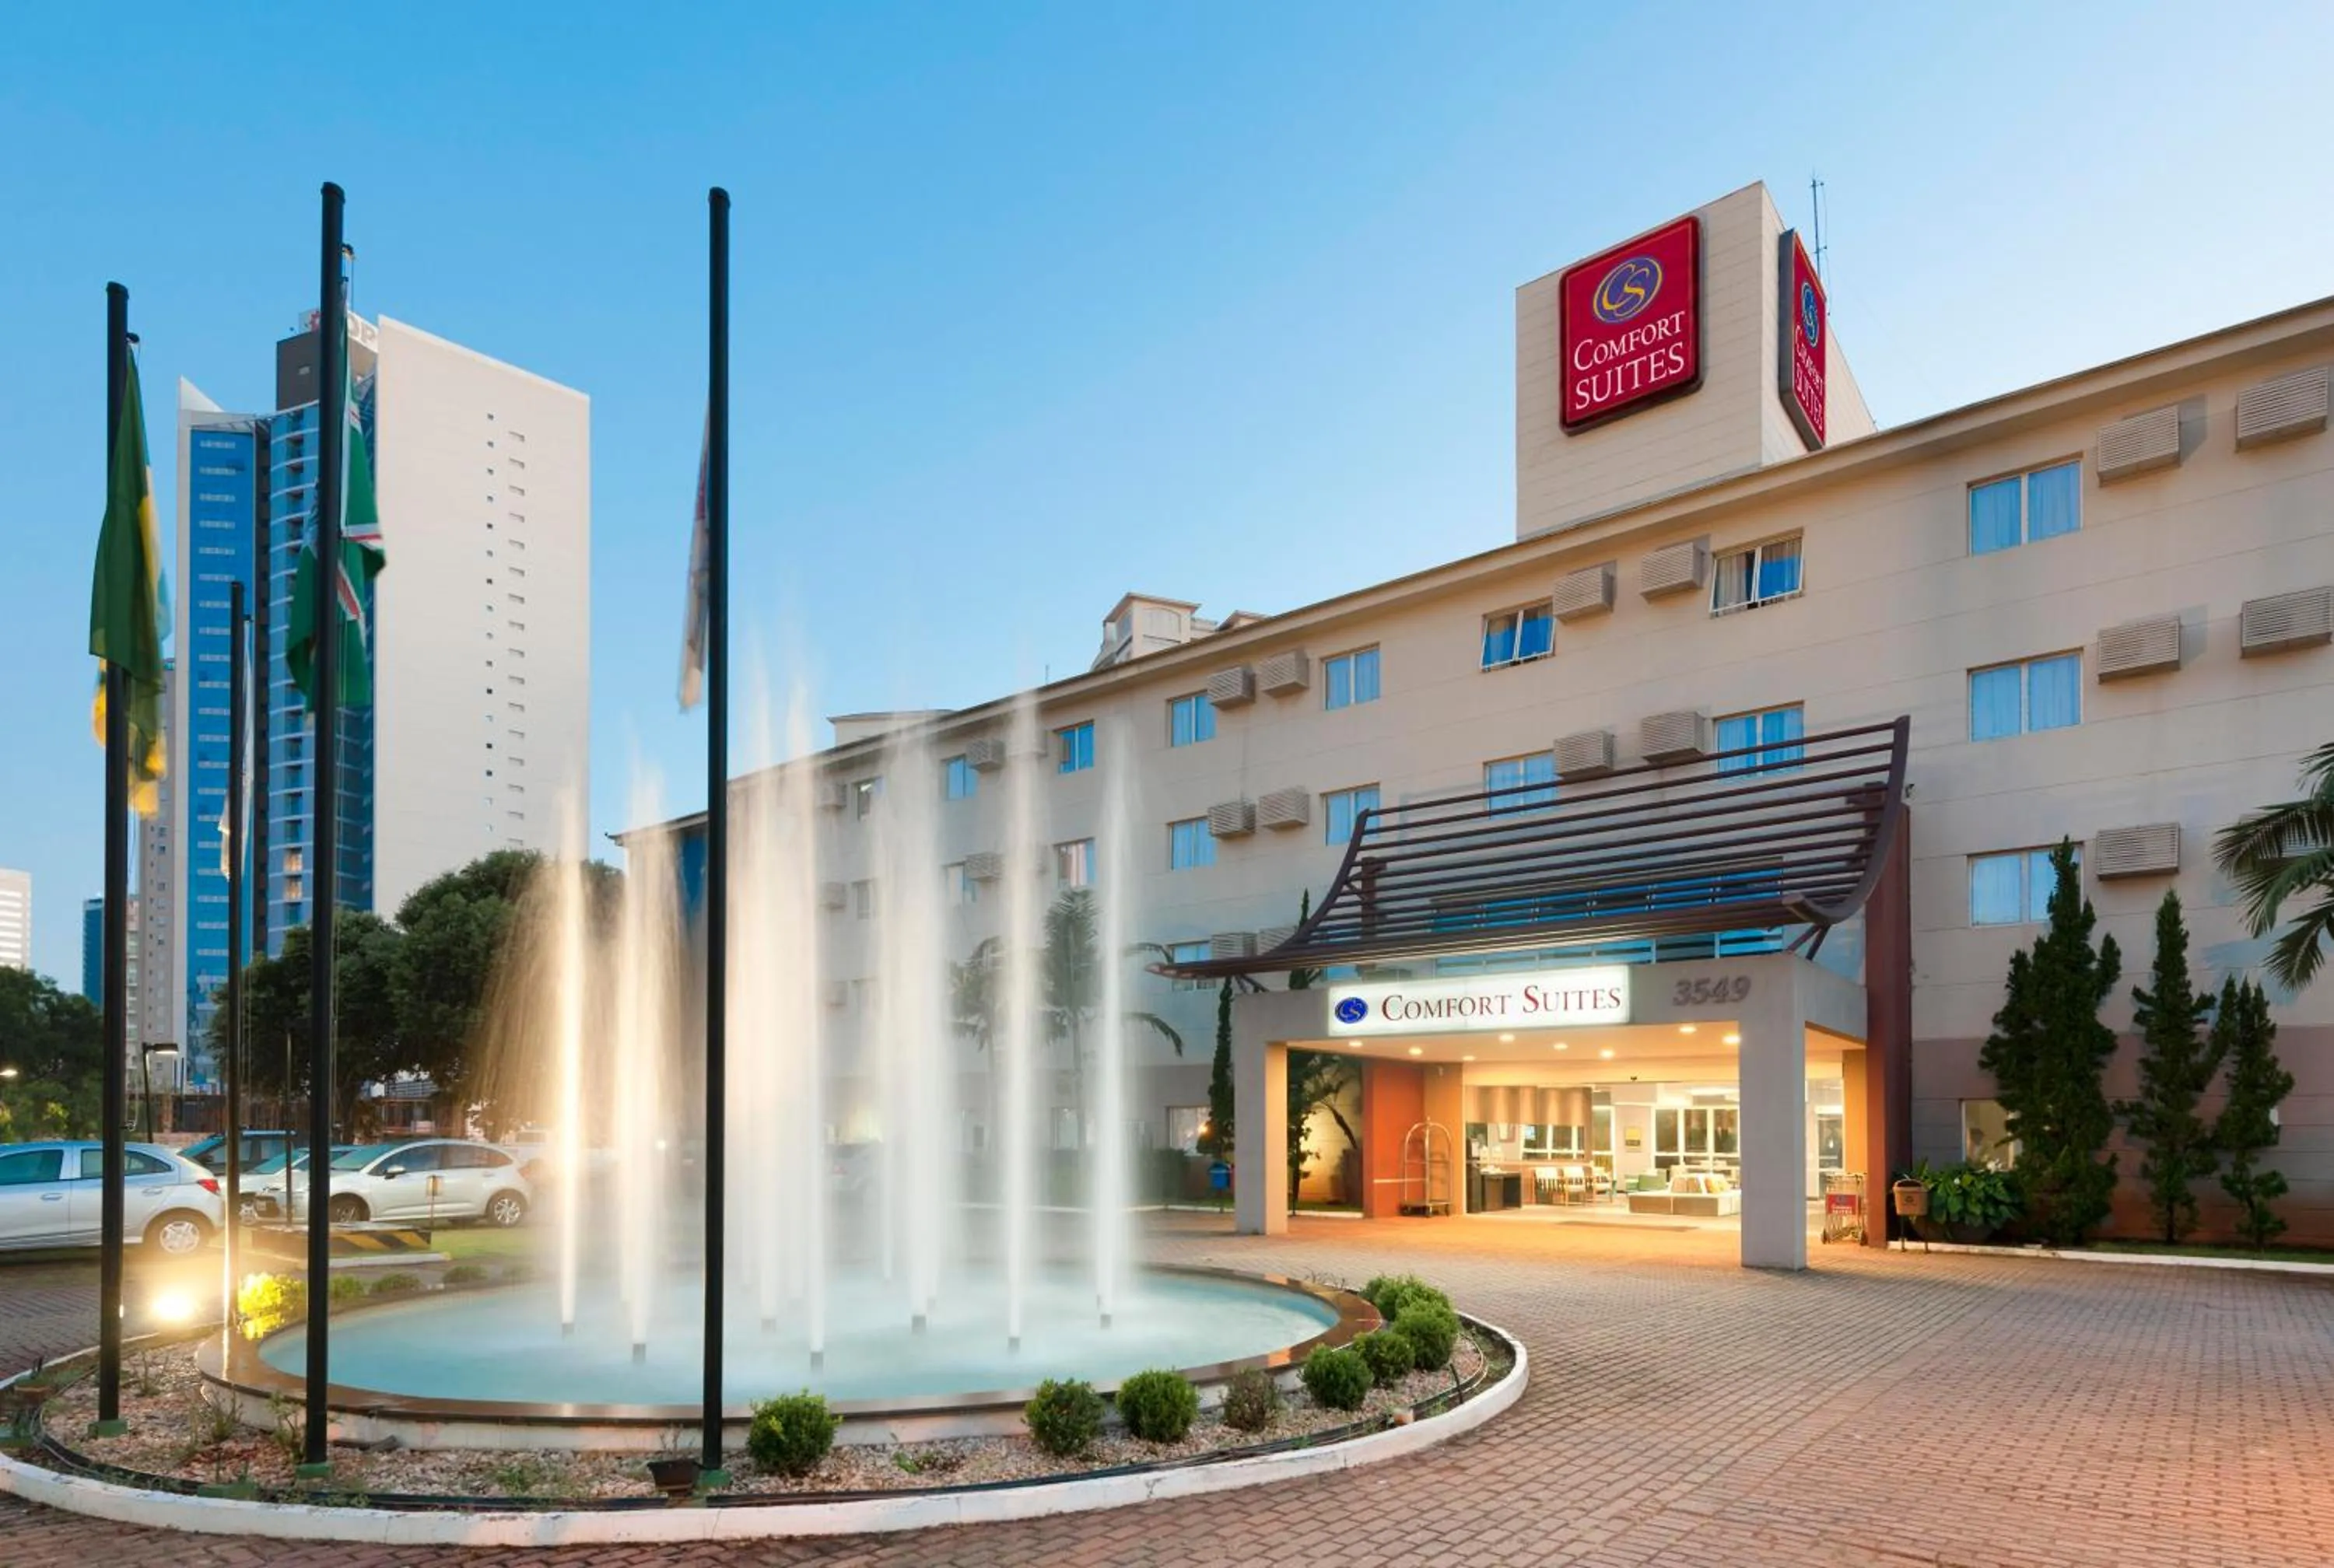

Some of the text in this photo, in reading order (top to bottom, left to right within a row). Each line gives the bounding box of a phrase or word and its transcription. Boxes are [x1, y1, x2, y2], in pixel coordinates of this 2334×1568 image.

[1574, 310, 1685, 371] COMFORT
[1575, 342, 1685, 410] SUITES
[1381, 993, 1512, 1021] COMFORT
[1522, 985, 1621, 1013] SUITES
[1672, 975, 1751, 1006] 3549
